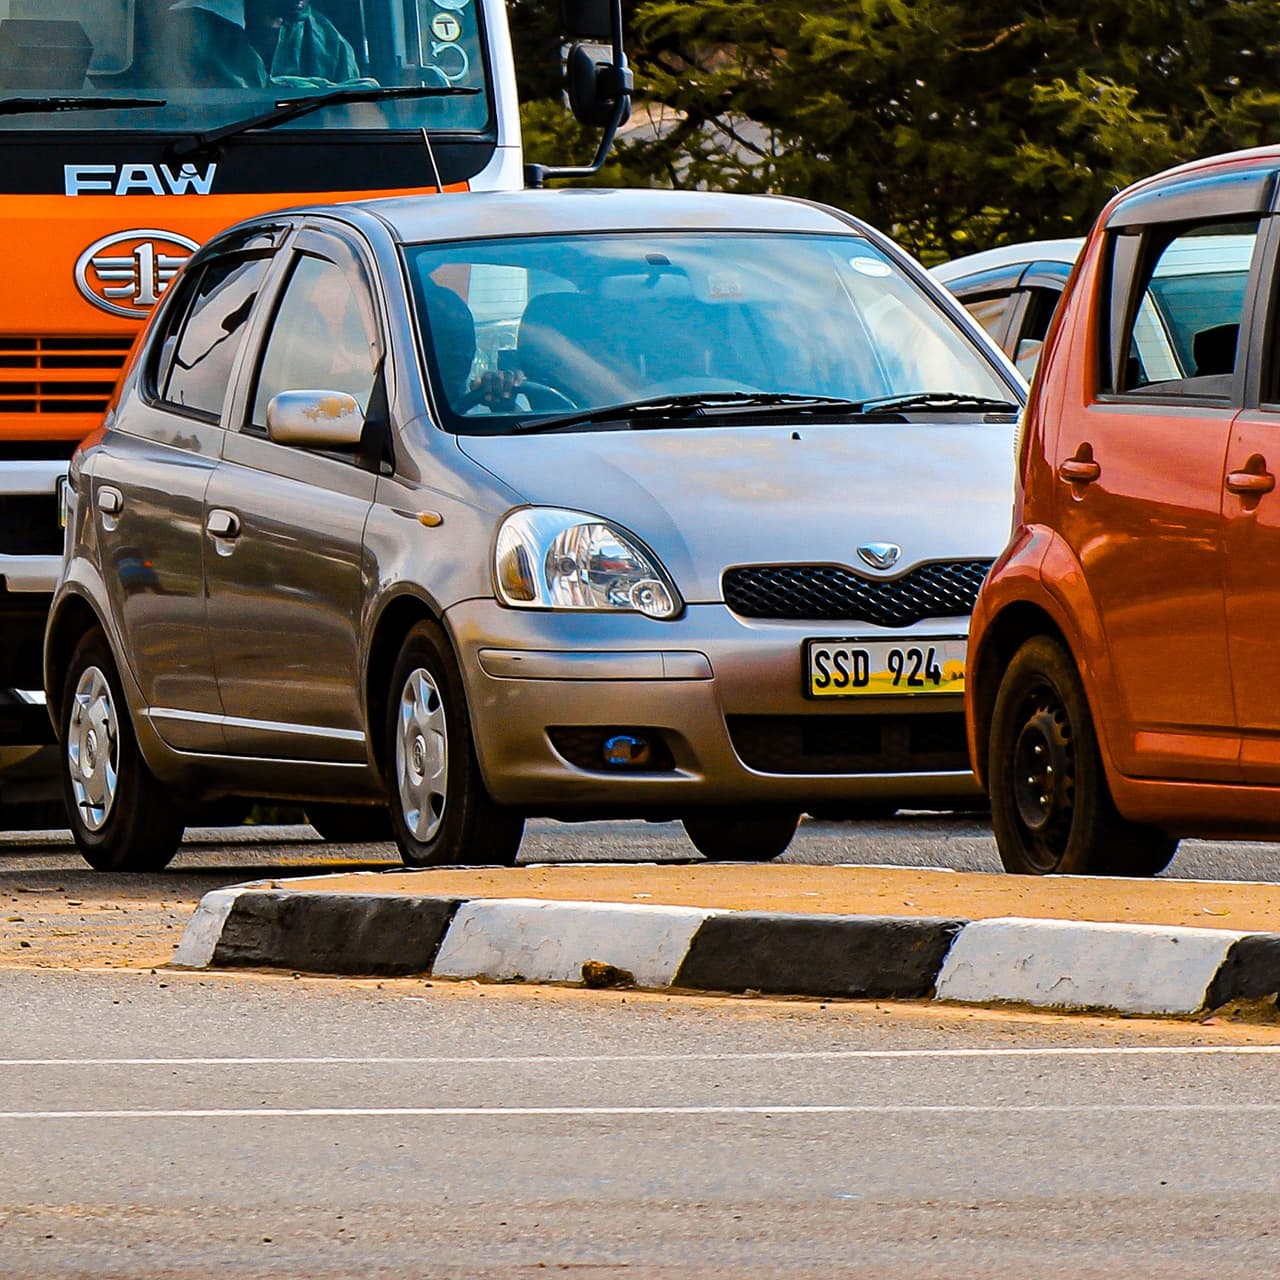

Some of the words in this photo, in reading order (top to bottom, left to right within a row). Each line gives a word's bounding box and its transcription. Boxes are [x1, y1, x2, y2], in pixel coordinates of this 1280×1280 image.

[64, 163, 217, 196] FAW
[815, 649, 870, 688] SSD
[888, 647, 942, 687] 924
